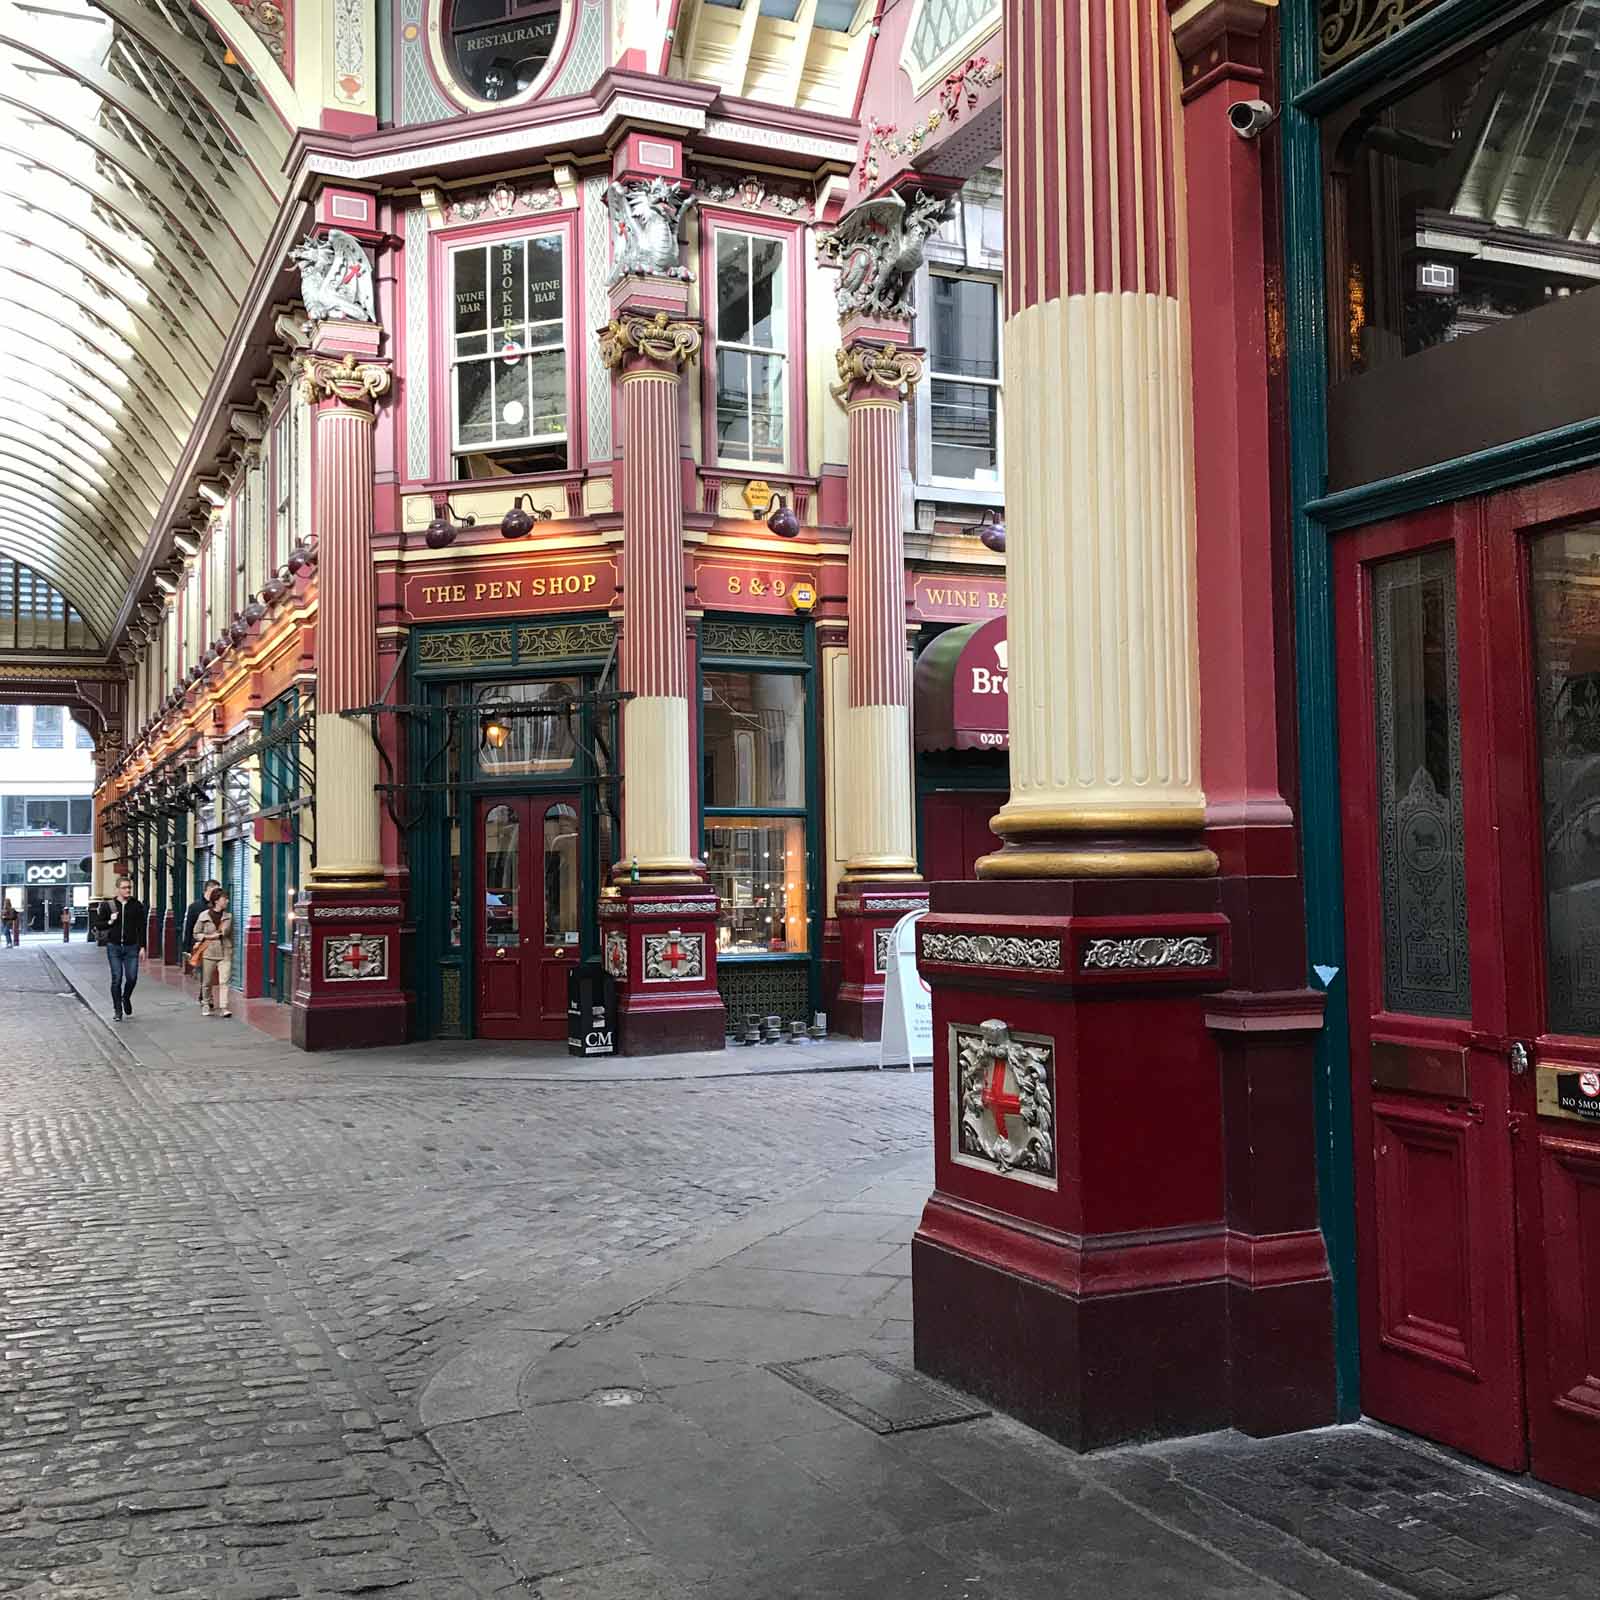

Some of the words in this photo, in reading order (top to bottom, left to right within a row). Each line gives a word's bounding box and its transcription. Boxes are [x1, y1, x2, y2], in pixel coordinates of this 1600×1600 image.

[466, 23, 554, 51] RESTAURANT
[531, 279, 560, 292] WINE
[456, 290, 485, 303] WINE
[535, 291, 556, 303] BAR
[460, 302, 481, 314] BAR
[422, 584, 466, 604] THE
[474, 580, 522, 600] PEN
[532, 574, 596, 596] SHOP
[728, 575, 741, 594] 8
[749, 577, 768, 596] &
[773, 579, 786, 597] 9
[926, 588, 980, 608] WINE
[980, 733, 1003, 744] 020
[27, 862, 66, 883] pod
[585, 1031, 613, 1047] CM
[1562, 1096, 1576, 1107] NO
[1578, 1098, 1600, 1110] SMO
